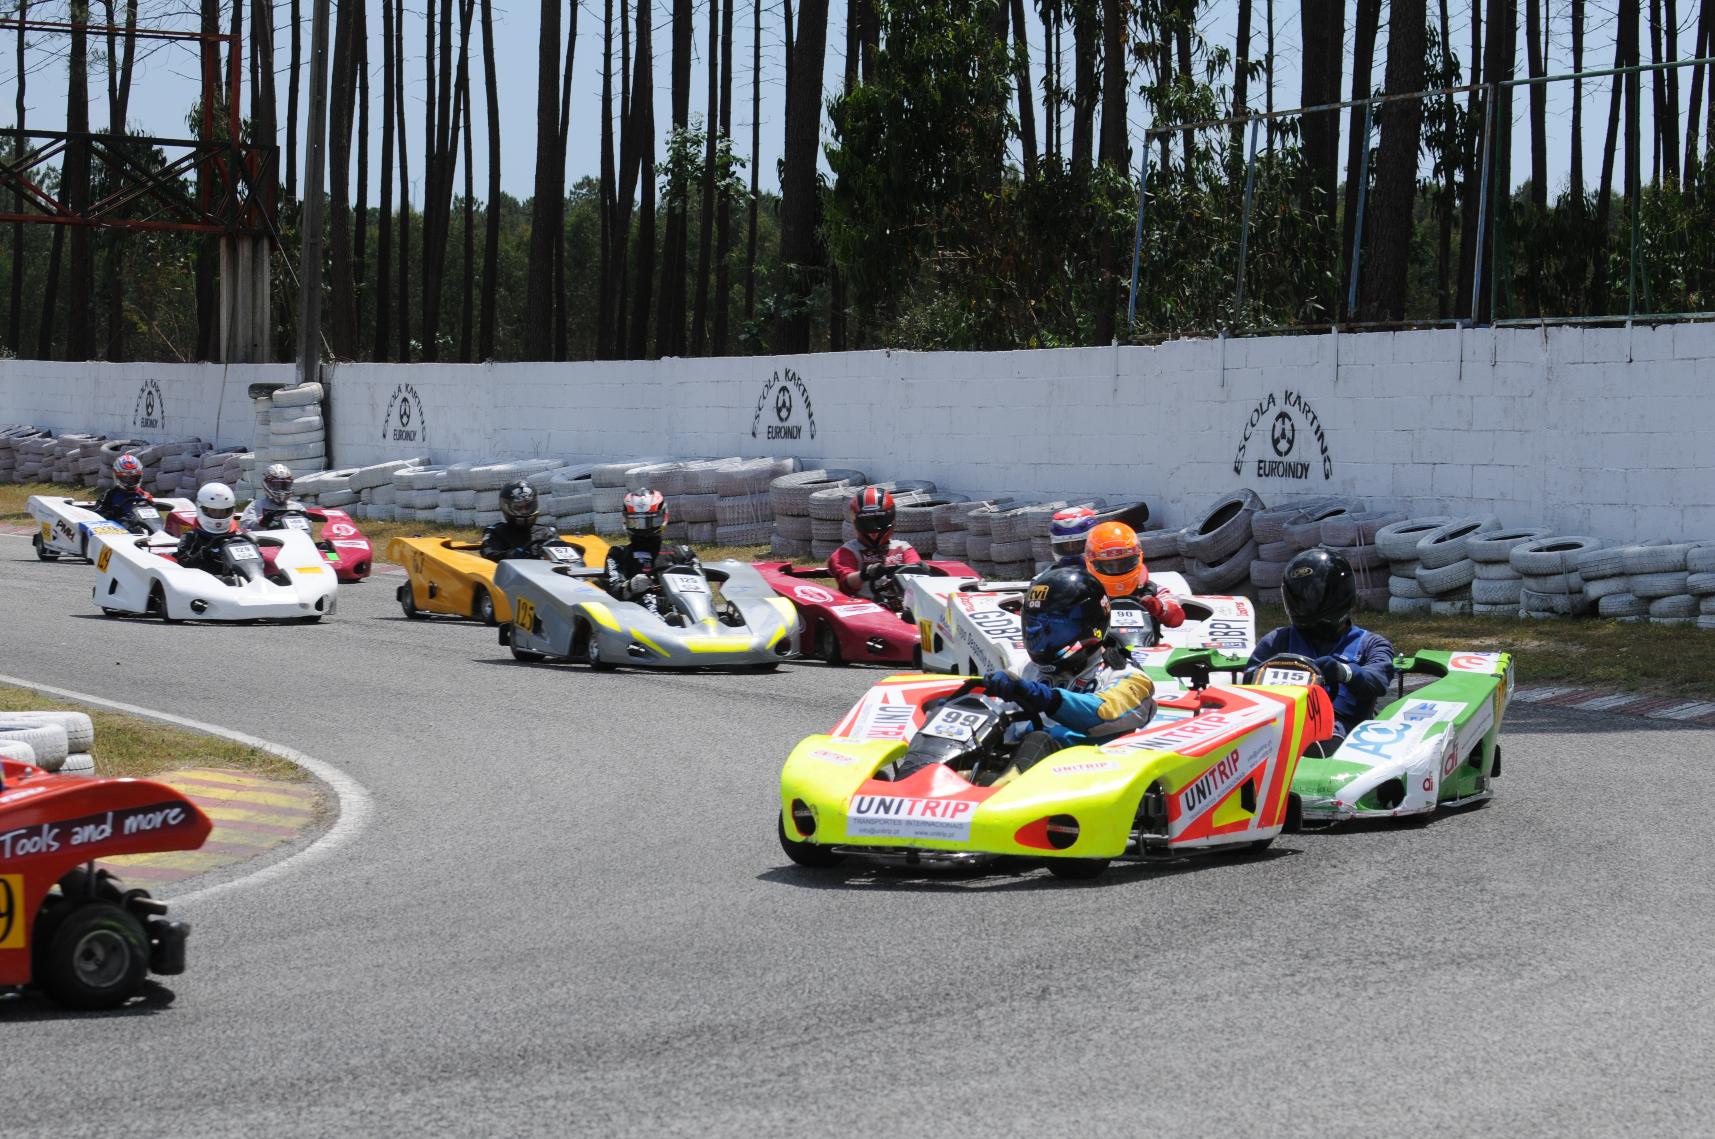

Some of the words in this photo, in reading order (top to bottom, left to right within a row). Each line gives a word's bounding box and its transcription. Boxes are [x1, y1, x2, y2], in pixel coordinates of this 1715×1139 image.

[752, 371, 780, 439] ESCOLA
[785, 368, 817, 440] KARTING
[393, 429, 417, 441] EUROINDY
[767, 425, 802, 440] EUROINDY
[1233, 393, 1276, 476] ESCOLA
[1284, 390, 1333, 480] KARTING
[1257, 459, 1310, 479] EUROINDY
[517, 599, 535, 632] 125
[1271, 670, 1305, 681] 115
[941, 710, 981, 727] 99
[1305, 687, 1322, 738] 99
[1184, 748, 1240, 812] UNITRIP
[856, 796, 970, 819] UNITRIP
[0, 824, 60, 858] Tools
[70, 811, 114, 845] and
[124, 807, 186, 835] more
[853, 818, 902, 826] TRANSPORTES
[905, 820, 964, 830] INTERNACIONAIS
